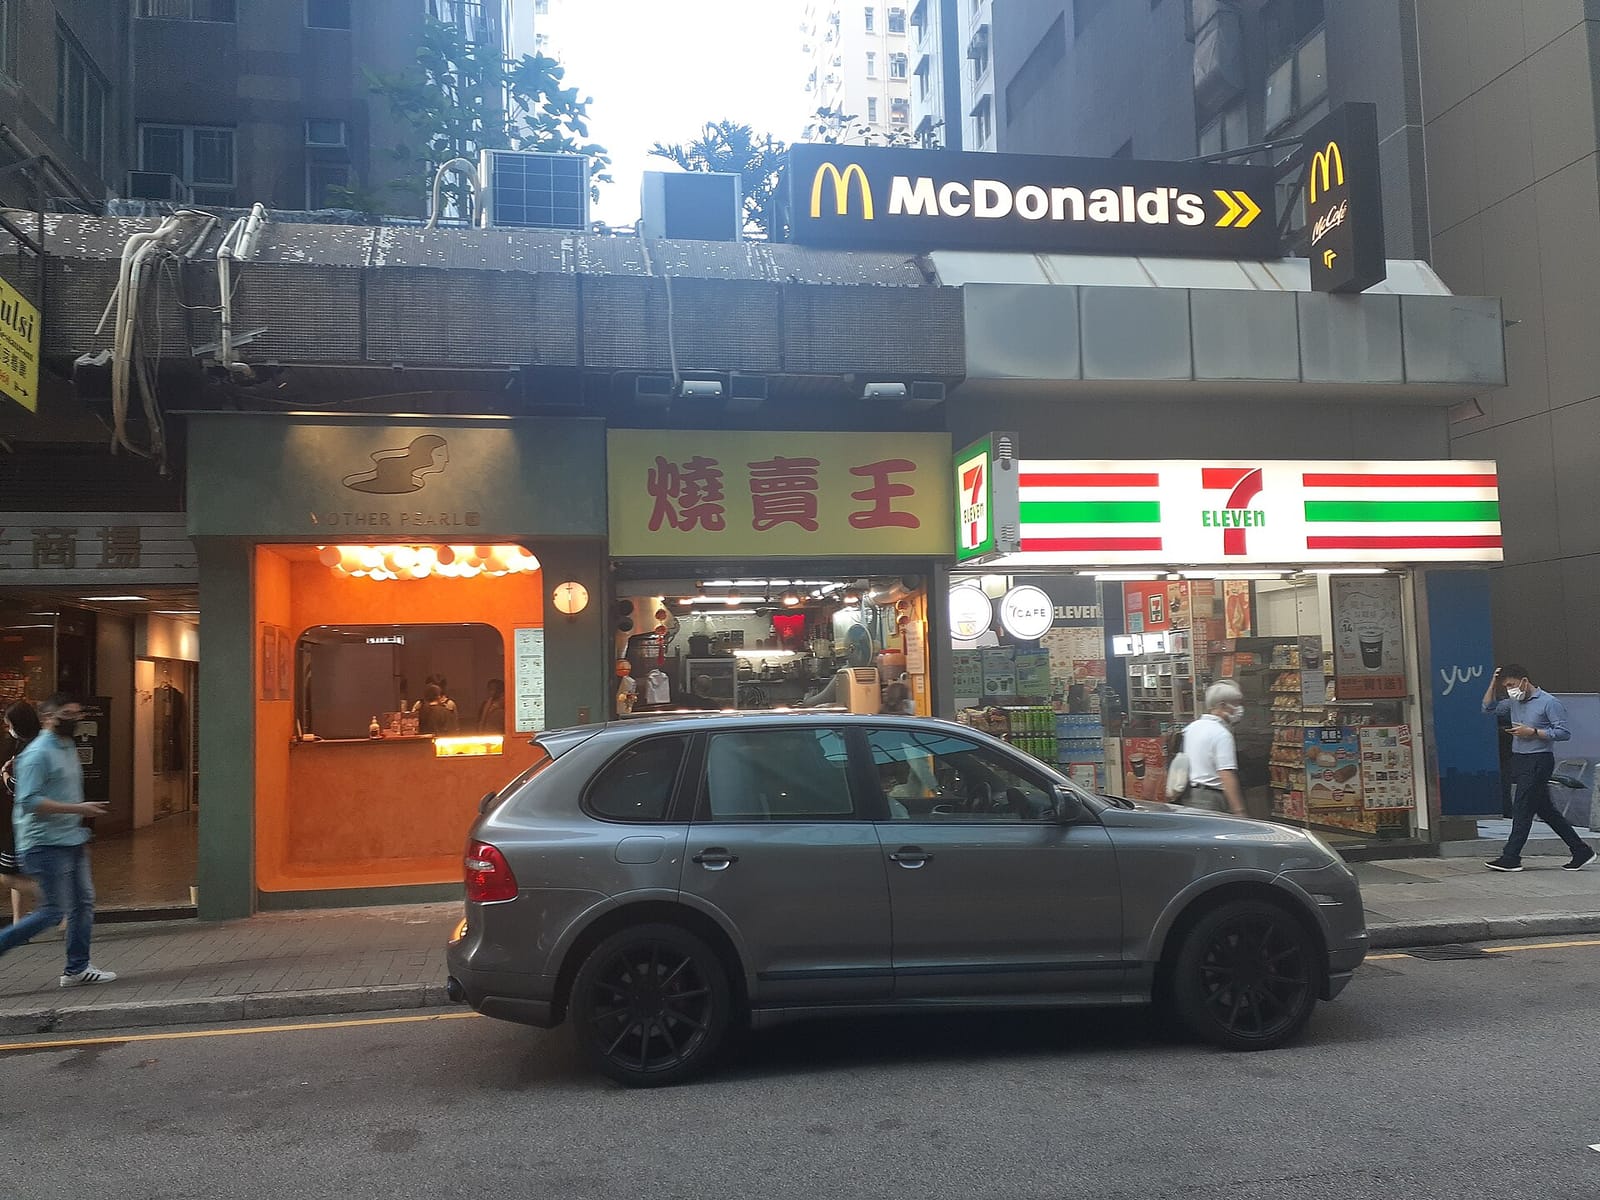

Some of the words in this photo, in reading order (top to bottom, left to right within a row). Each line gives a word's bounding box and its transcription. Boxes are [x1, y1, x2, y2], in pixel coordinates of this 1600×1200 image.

[888, 175, 1206, 227] McDonald's
[647, 455, 921, 532] 燒賣王
[0, 528, 143, 569] 商場
[1440, 664, 1483, 696] yuu
